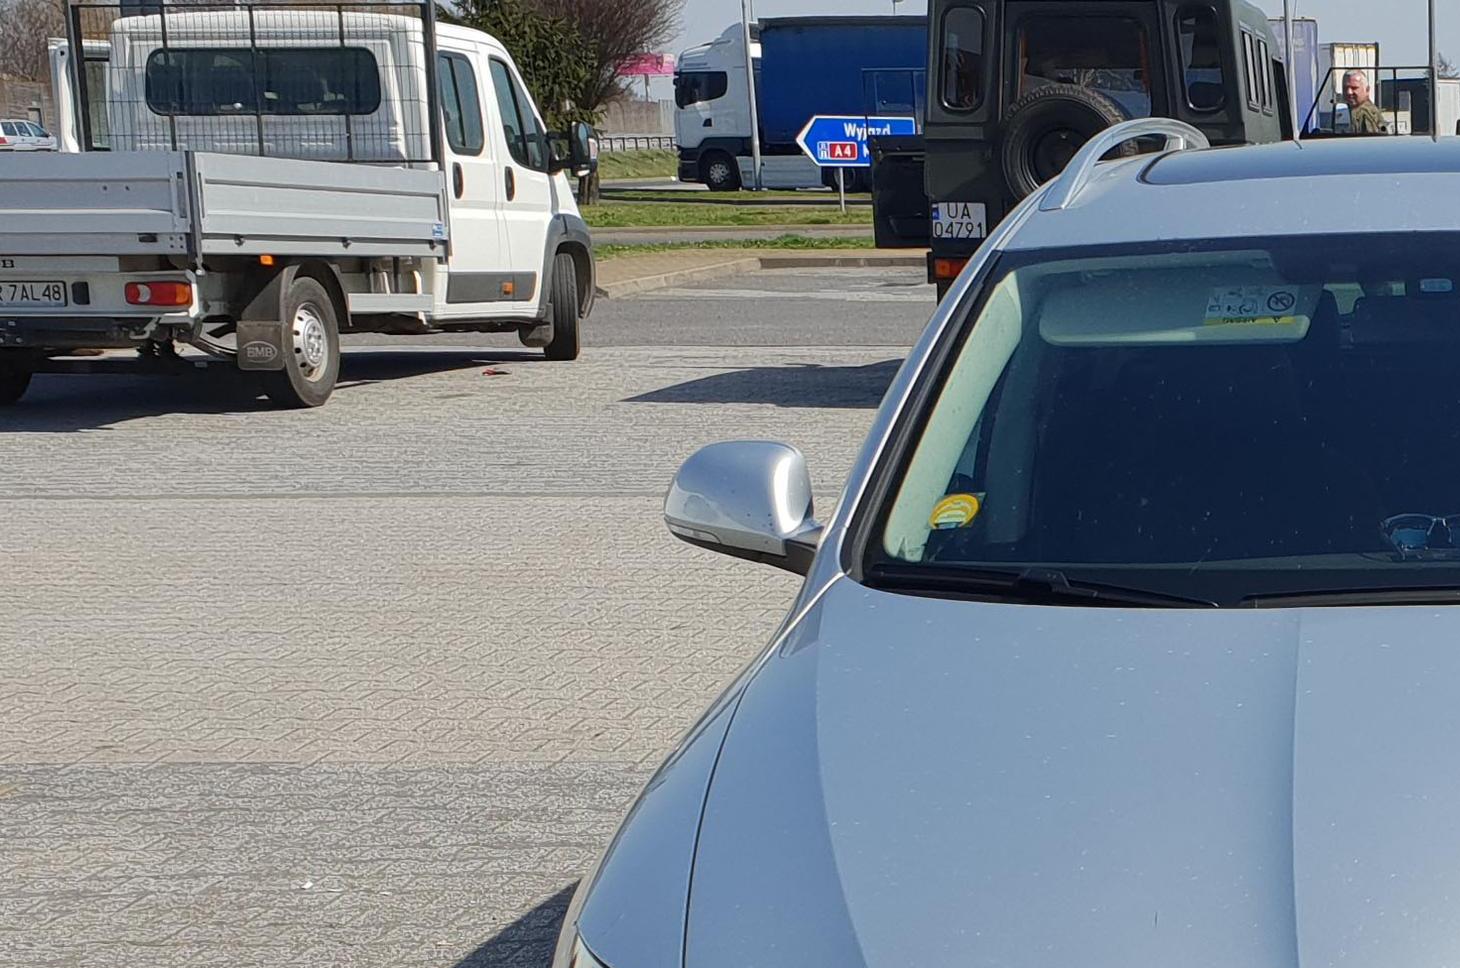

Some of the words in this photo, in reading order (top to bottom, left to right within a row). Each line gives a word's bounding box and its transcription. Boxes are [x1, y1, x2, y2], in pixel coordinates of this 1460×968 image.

[834, 144, 852, 157] A4
[947, 202, 971, 219] UA
[934, 221, 983, 238] 04791
[9, 284, 61, 301] 7AL48
[247, 346, 273, 358] BMB
